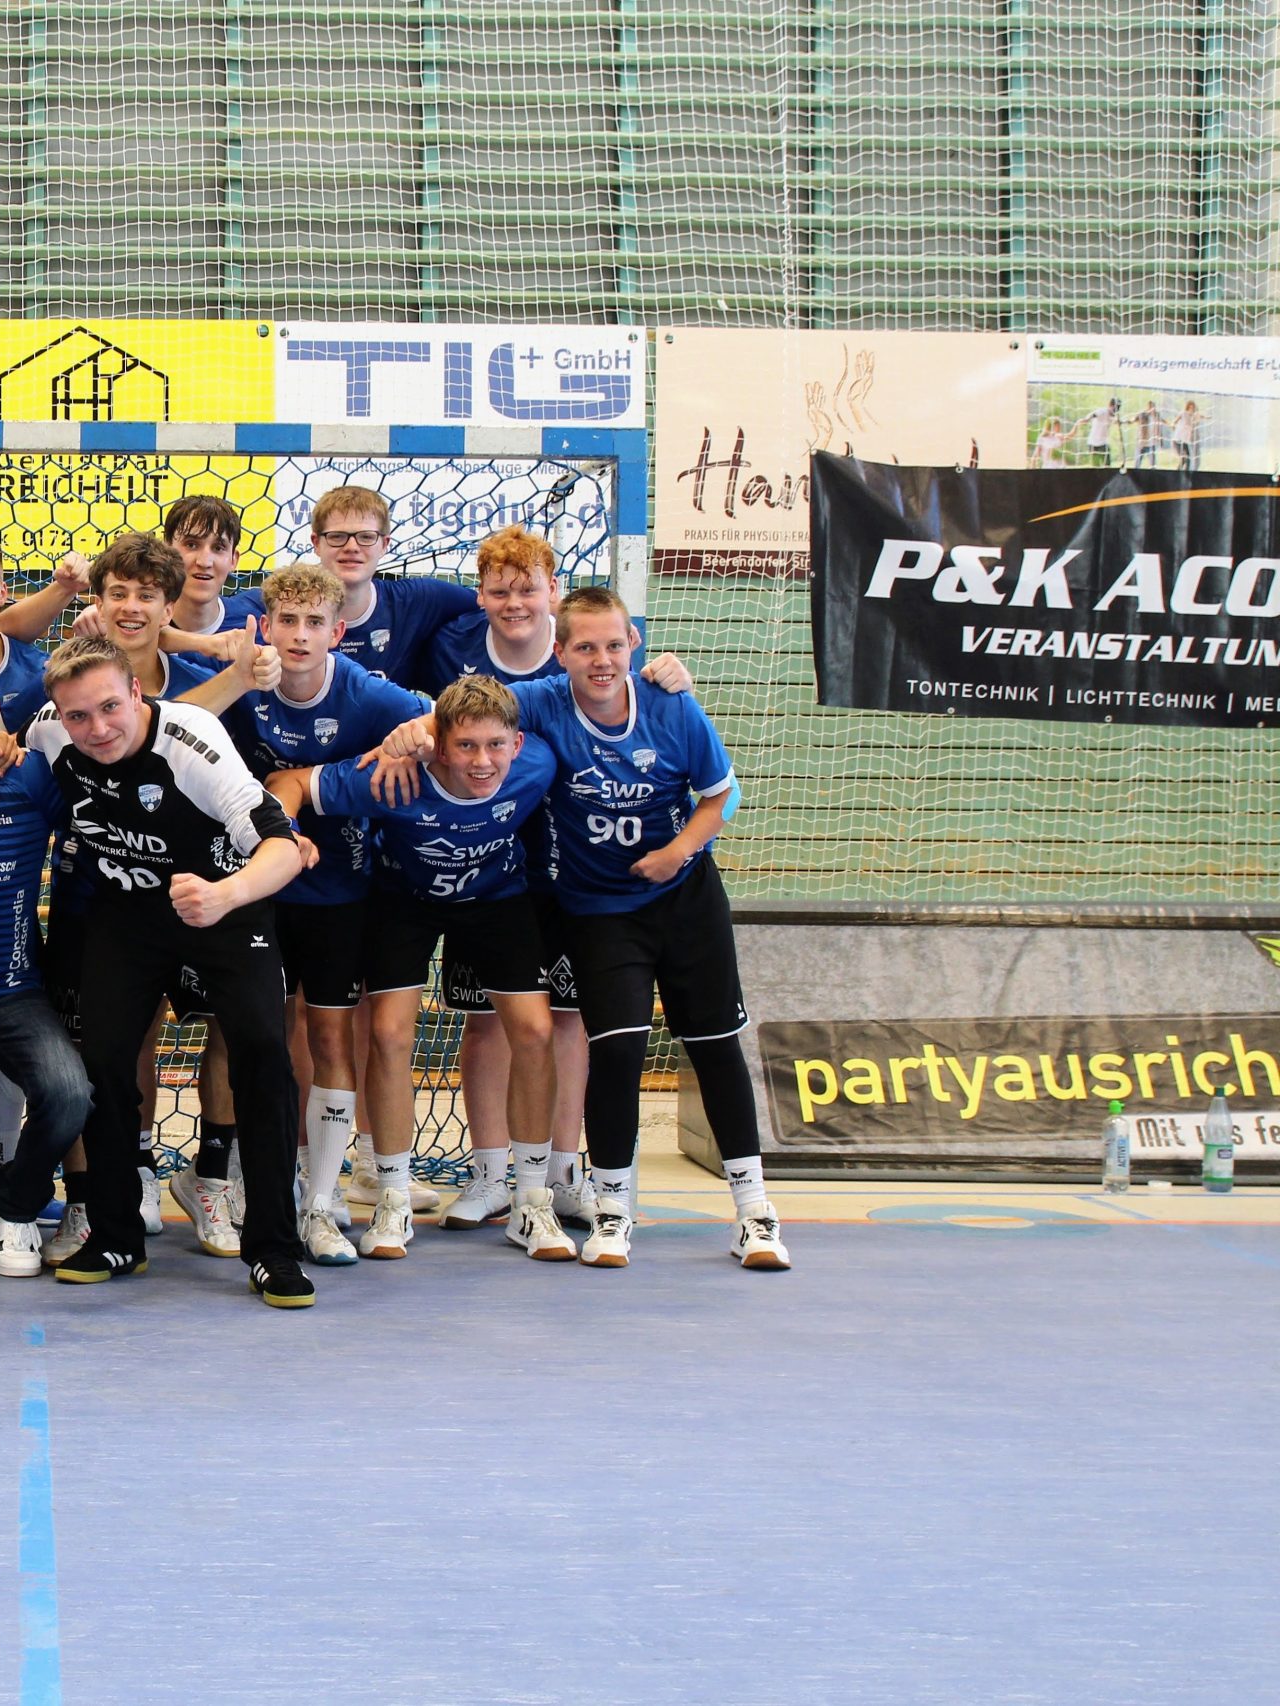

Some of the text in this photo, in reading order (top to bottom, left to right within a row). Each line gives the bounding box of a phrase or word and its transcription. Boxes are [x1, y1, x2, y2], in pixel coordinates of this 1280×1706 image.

[554, 348, 632, 370] GmbH
[1118, 357, 1252, 373] Praxisgemeinschaft
[684, 528, 810, 542] PRAXIS FÜR PHYSIOTHERA
[792, 556, 810, 568] Str
[865, 538, 1280, 618] P&K ACO
[962, 625, 1280, 668] VERANSTALTUN
[907, 679, 1039, 703] TONTECHNIK
[1066, 688, 1217, 710] LICHTTECHNIK
[600, 779, 655, 799] SWD
[586, 813, 643, 847] 90
[451, 838, 505, 860] SWD
[793, 1033, 1280, 1124] partyausrich
[321, 1114, 349, 1125] erima
[1136, 1117, 1186, 1148] Mit
